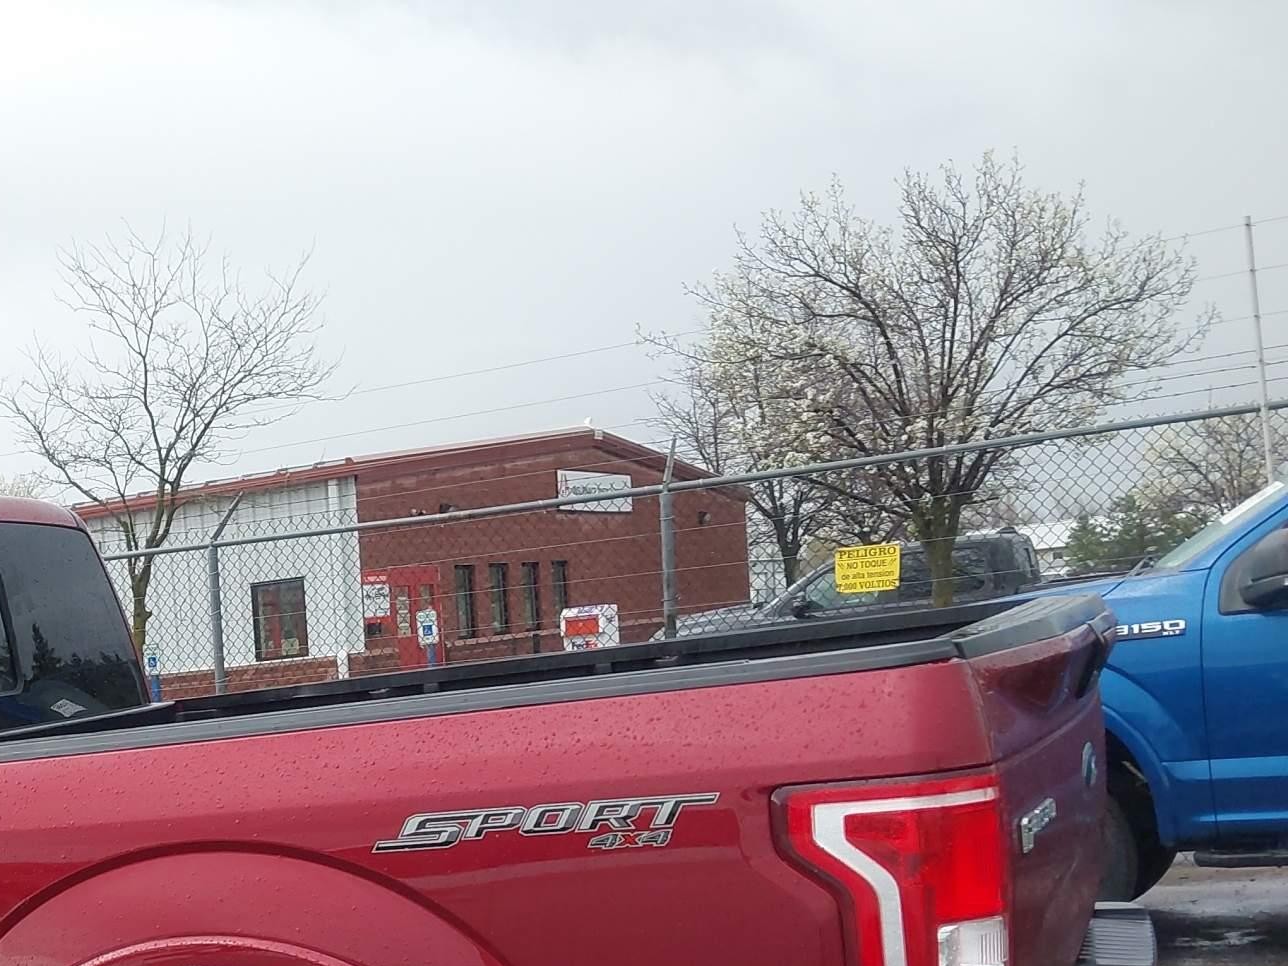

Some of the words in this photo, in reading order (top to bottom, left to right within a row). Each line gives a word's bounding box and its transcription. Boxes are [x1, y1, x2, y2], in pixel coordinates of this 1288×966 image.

[839, 546, 897, 559] PELIGRO
[860, 559, 888, 569] TOQUE
[859, 579, 897, 589] VOLTIOS
[372, 792, 720, 853] SPORT
